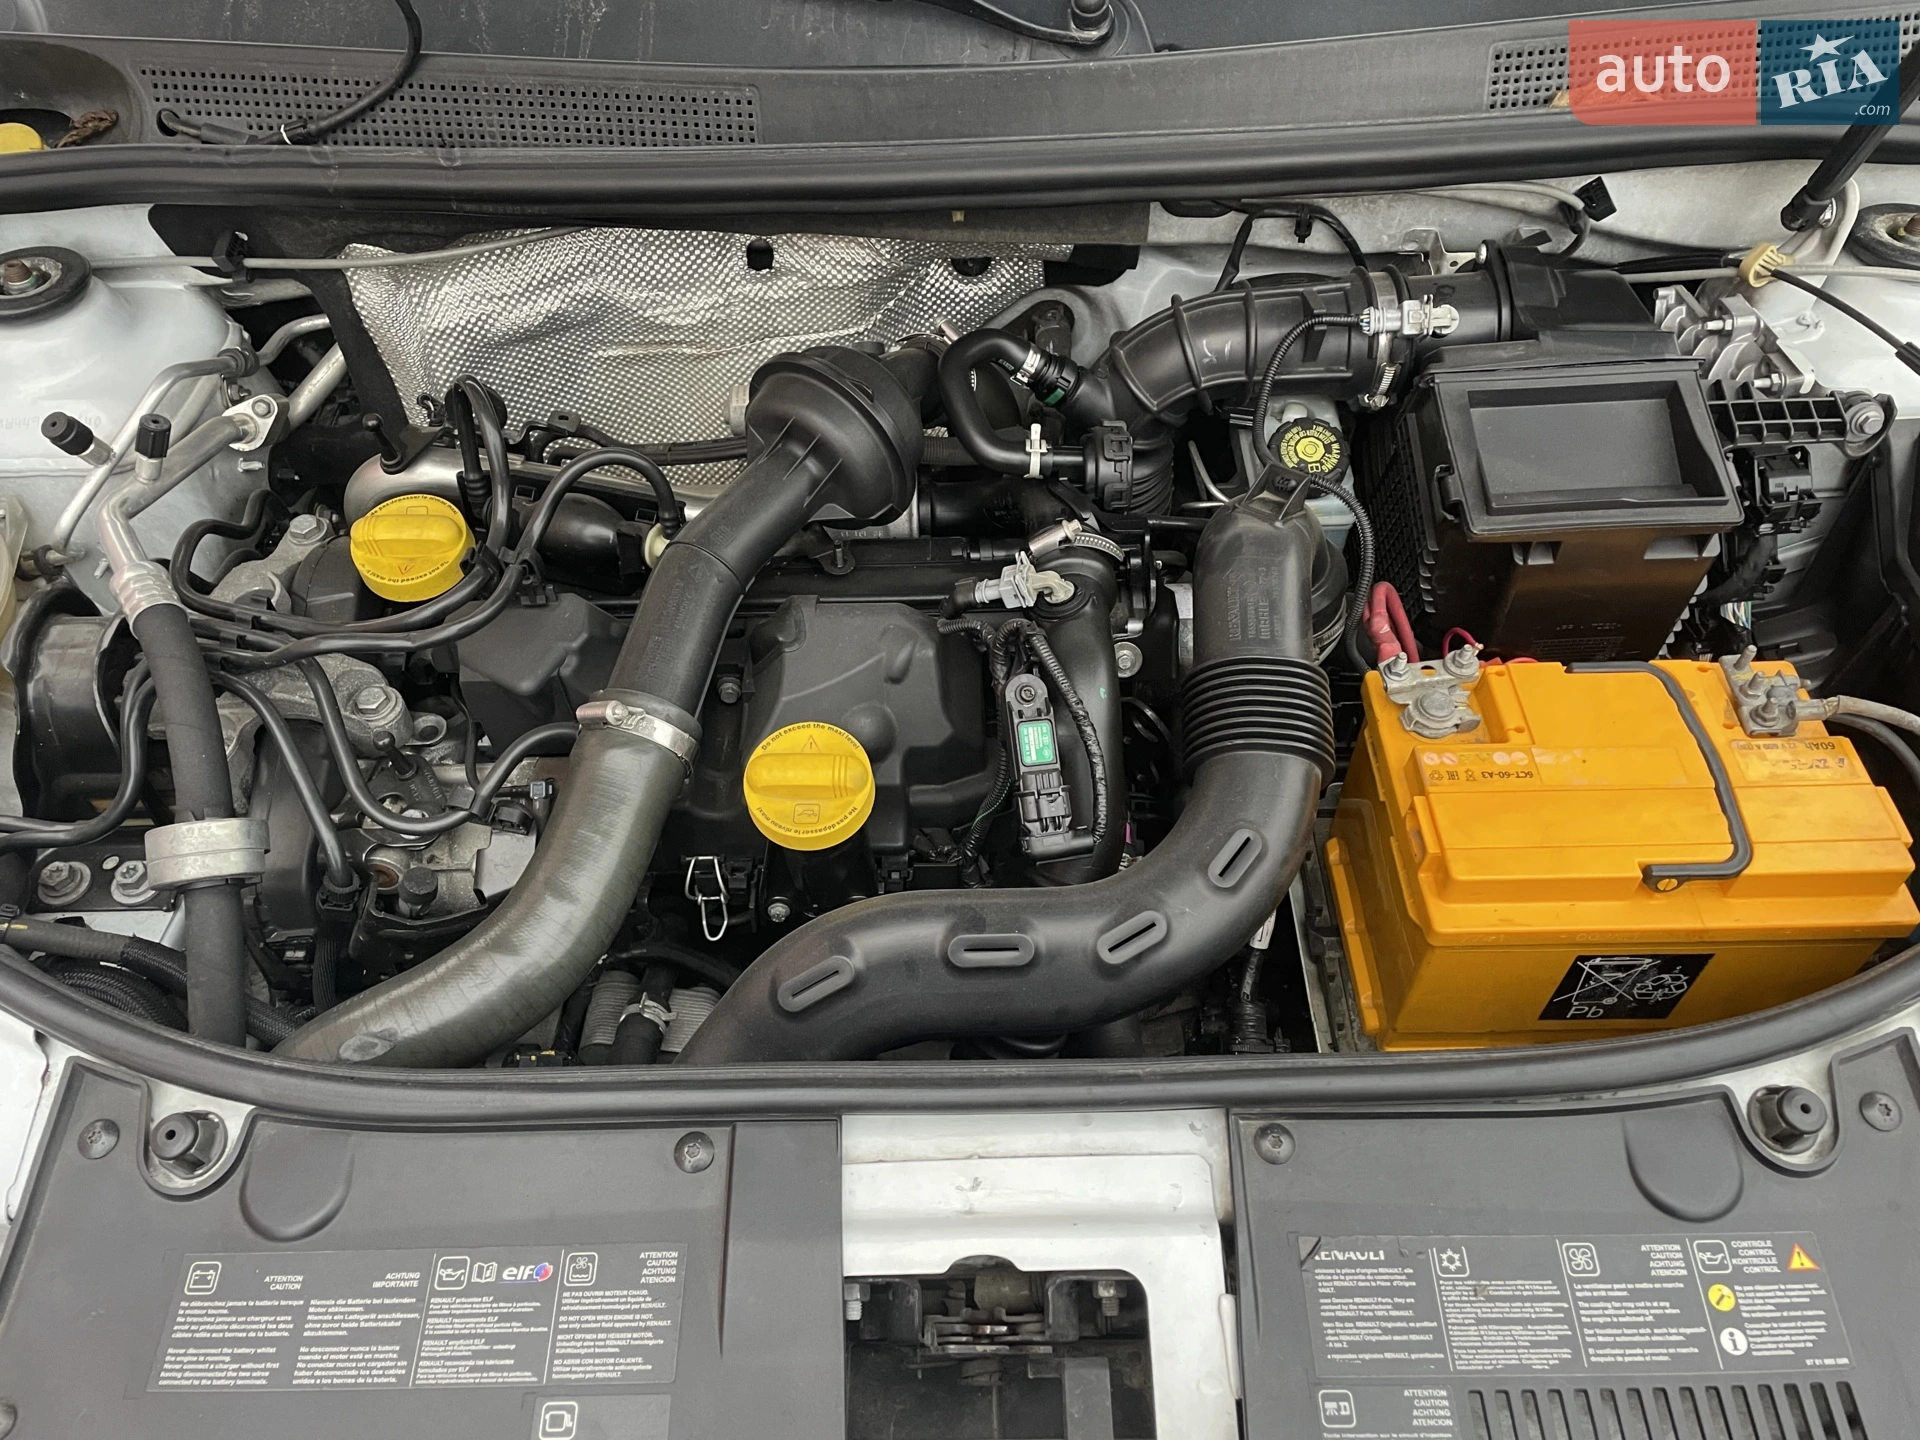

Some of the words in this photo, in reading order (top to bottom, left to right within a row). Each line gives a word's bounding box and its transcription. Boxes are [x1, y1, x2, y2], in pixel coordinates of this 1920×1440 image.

[1322, 442, 1340, 473] WARNING
[401, 572, 427, 583] exceed
[761, 742, 771, 751] Do
[771, 732, 783, 742] not
[784, 723, 811, 735] exceed
[827, 726, 845, 736] maxi
[845, 734, 859, 750] level
[1804, 742, 1836, 751] 60Ah
[756, 807, 771, 821] maxi
[848, 806, 858, 817] Ne
[837, 814, 848, 825] pas
[770, 820, 793, 833] niveau
[1566, 1005, 1604, 1019] Pb
[385, 1272, 420, 1280] ACHTUNG
[502, 1265, 536, 1280] elf
[640, 1276, 675, 1284] ATENCION
[1413, 1418, 1453, 1426] ATENCION
